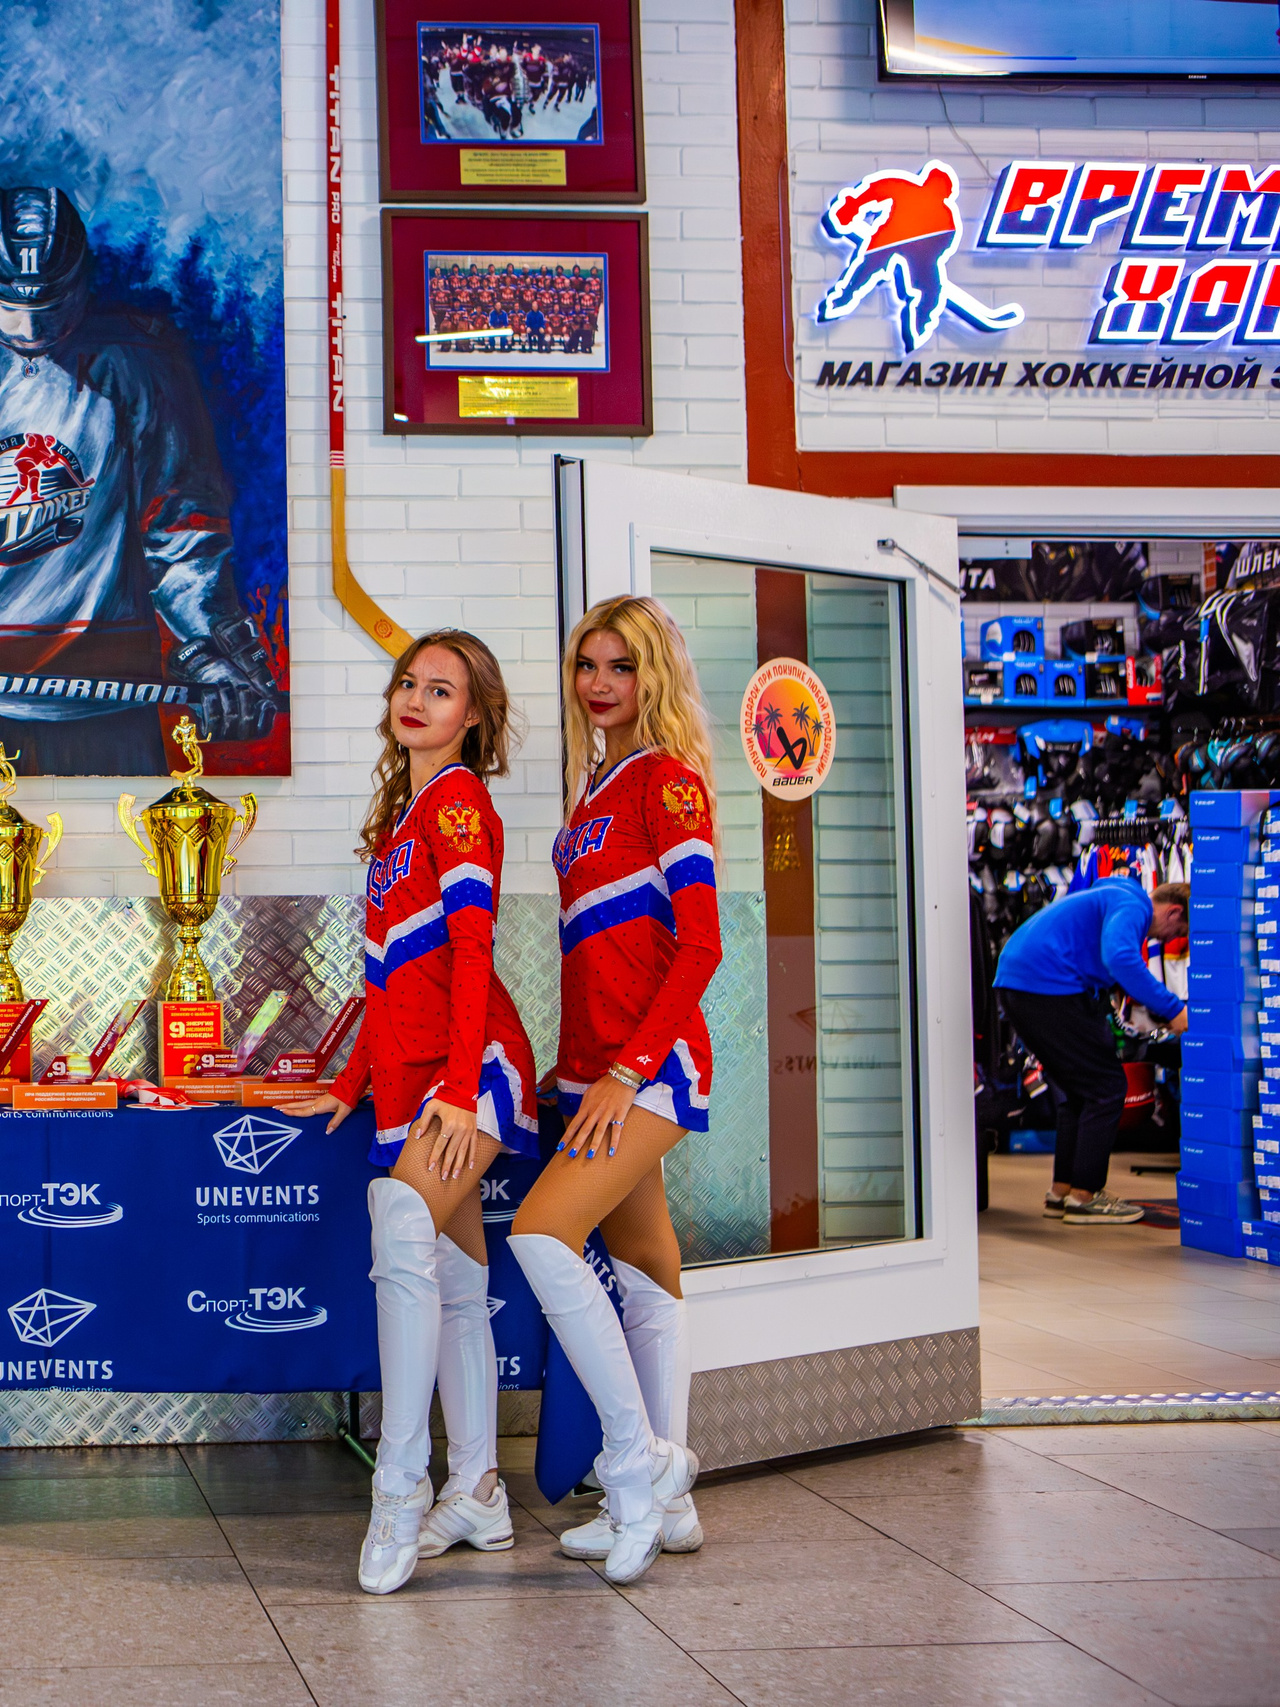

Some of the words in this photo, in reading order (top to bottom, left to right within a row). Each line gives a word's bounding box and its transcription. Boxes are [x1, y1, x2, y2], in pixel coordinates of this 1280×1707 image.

[329, 65, 341, 183] TITAN
[330, 191, 340, 224] PRO
[978, 160, 1280, 250] ВРЕМ
[19, 247, 40, 274] 11
[331, 292, 343, 412] TITAN
[817, 361, 1008, 388] МАГАЗИН
[1020, 357, 1263, 388] ХОККЕЙНОЙ
[758, 670, 772, 686] ПРИ
[772, 664, 806, 682] ПОКУПКЕ
[744, 684, 761, 734] ПОДАРОК
[807, 676, 828, 711] ЛЮБОЙ
[746, 737, 767, 778] ПОЛУЧИ
[816, 712, 833, 776] ПРОДУКЦИИ
[169, 1021, 185, 1038] 9
[321, 1032, 336, 1055] ЛУЧШИЙ
[335, 1001, 356, 1033] АССИСТЕНТ
[52, 1062, 66, 1076] 9
[201, 1054, 214, 1068] 9
[278, 1060, 292, 1073] 9
[196, 1185, 320, 1208] UNEVENTS
[197, 1212, 231, 1226] Sports
[234, 1211, 320, 1224] communications
